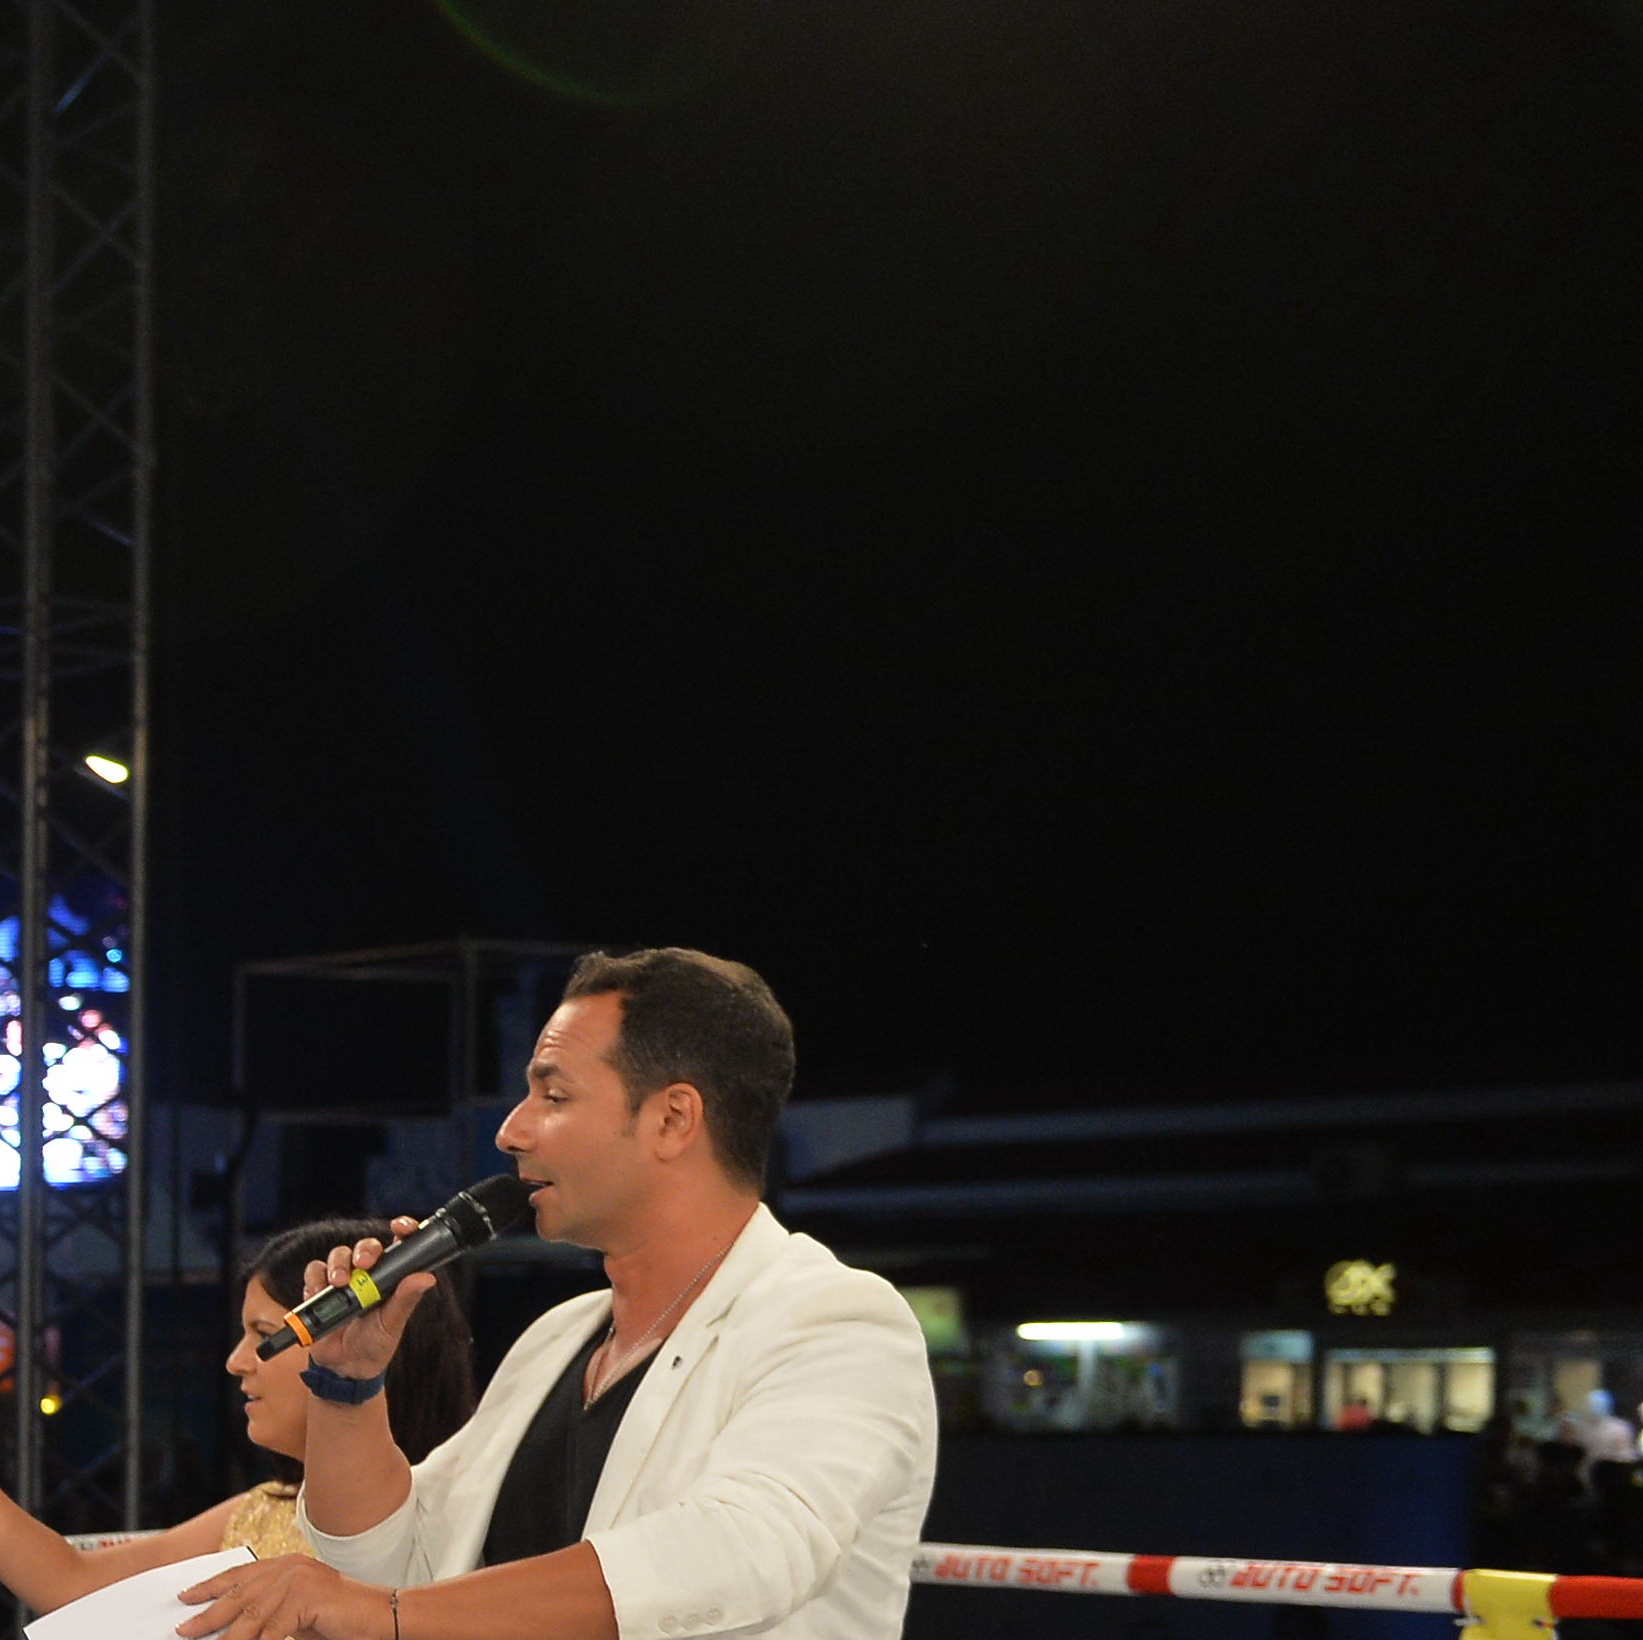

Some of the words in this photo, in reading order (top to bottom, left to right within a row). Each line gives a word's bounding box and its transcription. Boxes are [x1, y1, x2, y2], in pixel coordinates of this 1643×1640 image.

[934, 1554, 1013, 1581] AUTO
[1017, 1557, 1102, 1586] SOFT
[1230, 1563, 1321, 1591] AUTO
[1324, 1567, 1420, 1596] SOFT
